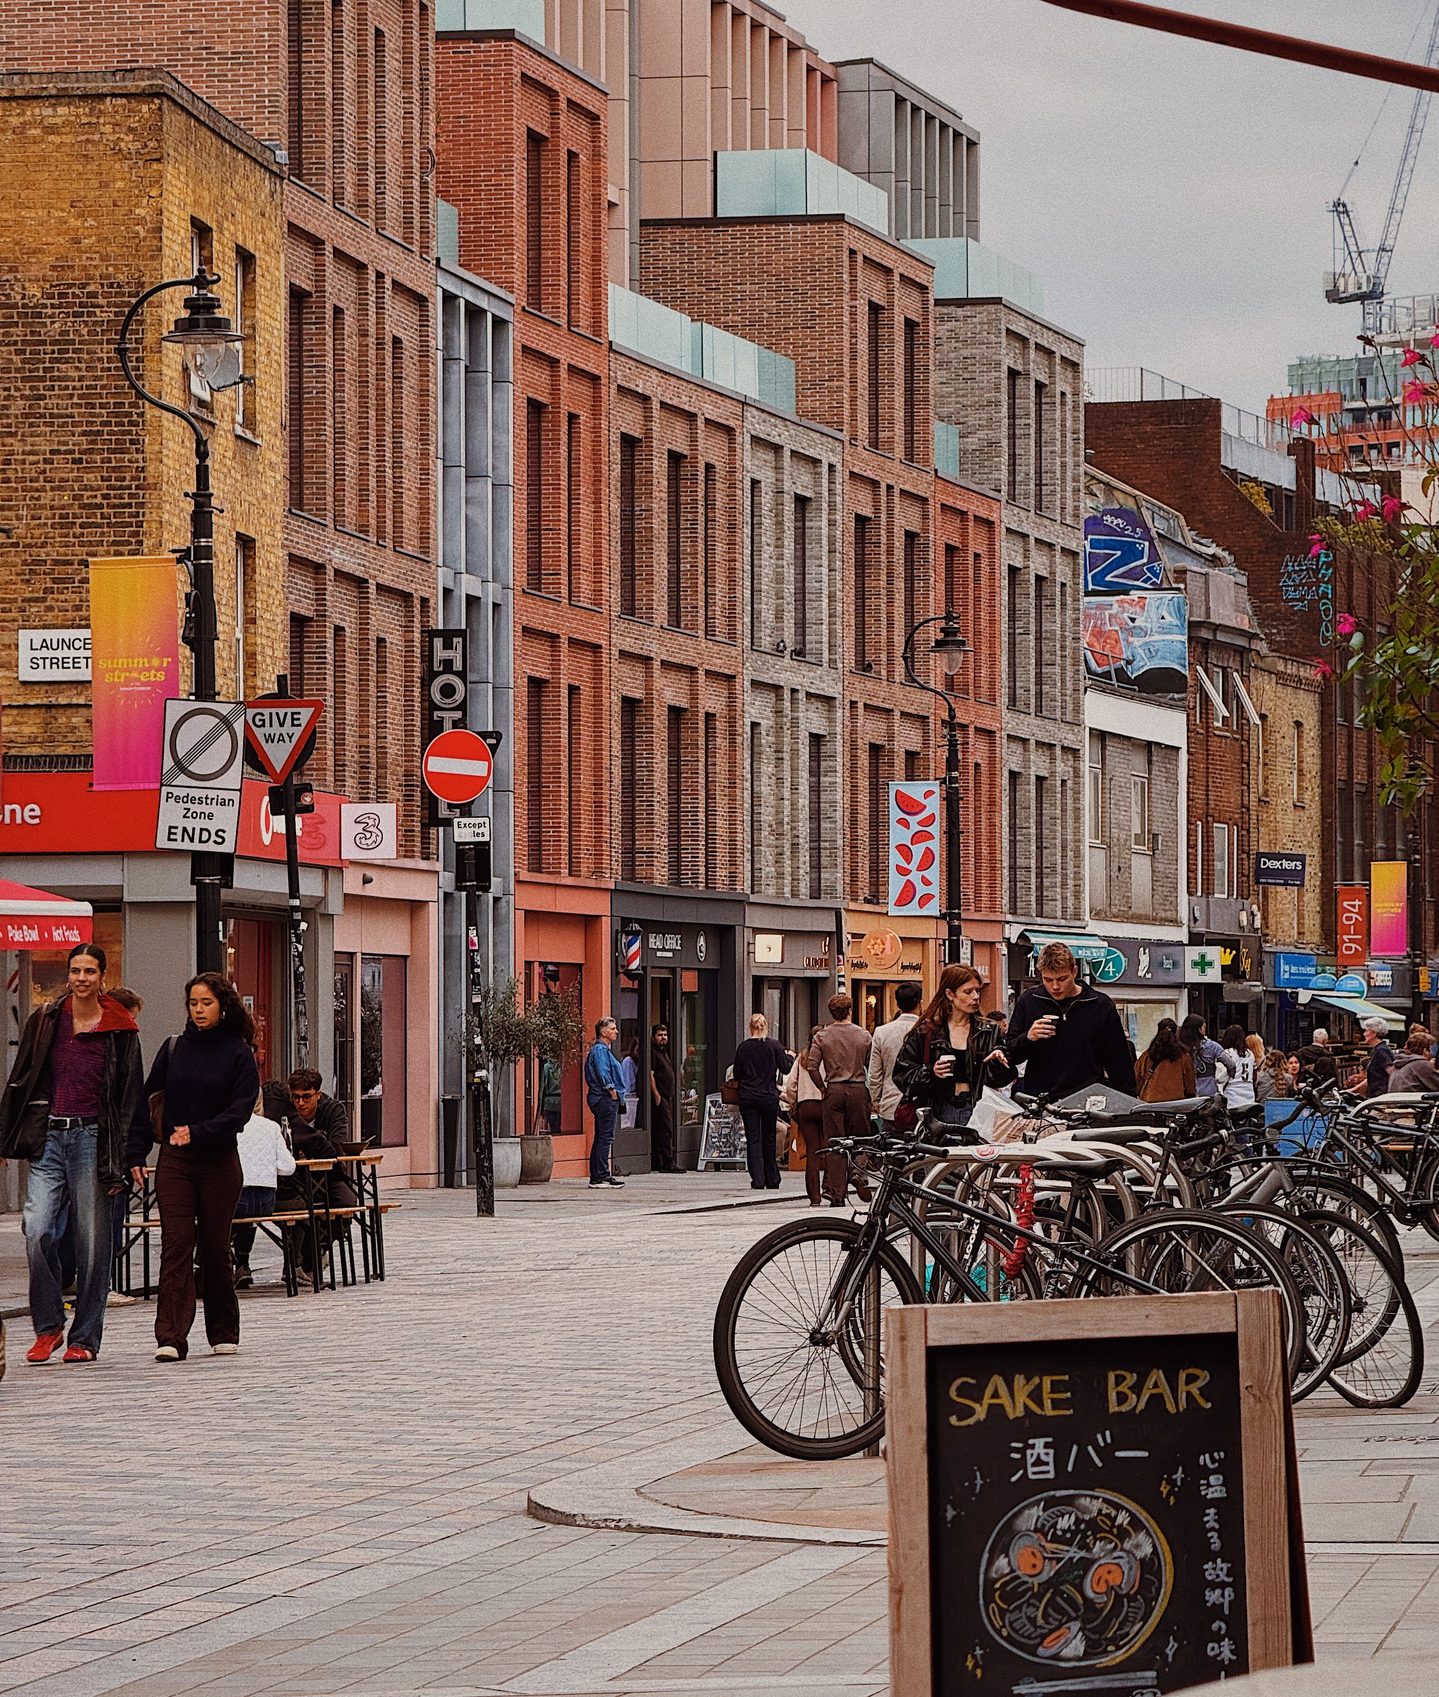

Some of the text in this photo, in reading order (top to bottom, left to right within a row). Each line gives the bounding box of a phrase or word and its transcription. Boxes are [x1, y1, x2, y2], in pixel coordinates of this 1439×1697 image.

[29, 656, 92, 670] STREET
[251, 711, 302, 728] GIVE
[430, 637, 466, 818] HOTL
[263, 732, 295, 744] WAY
[165, 791, 235, 808] Pedestrian
[0, 802, 42, 825] ne
[182, 808, 215, 821] Zone
[354, 812, 384, 850] 3
[457, 820, 487, 829] Except
[166, 825, 227, 845] ENDS
[1260, 857, 1302, 870] Dexters
[7, 924, 24, 942] Poke
[23, 924, 40, 942] Bowl
[1342, 898, 1362, 955] 91-94
[648, 933, 682, 950] HEAD OFFICE
[949, 1367, 1212, 1427] SAKE BAR
[1010, 1430, 1149, 1483] 酒バー
